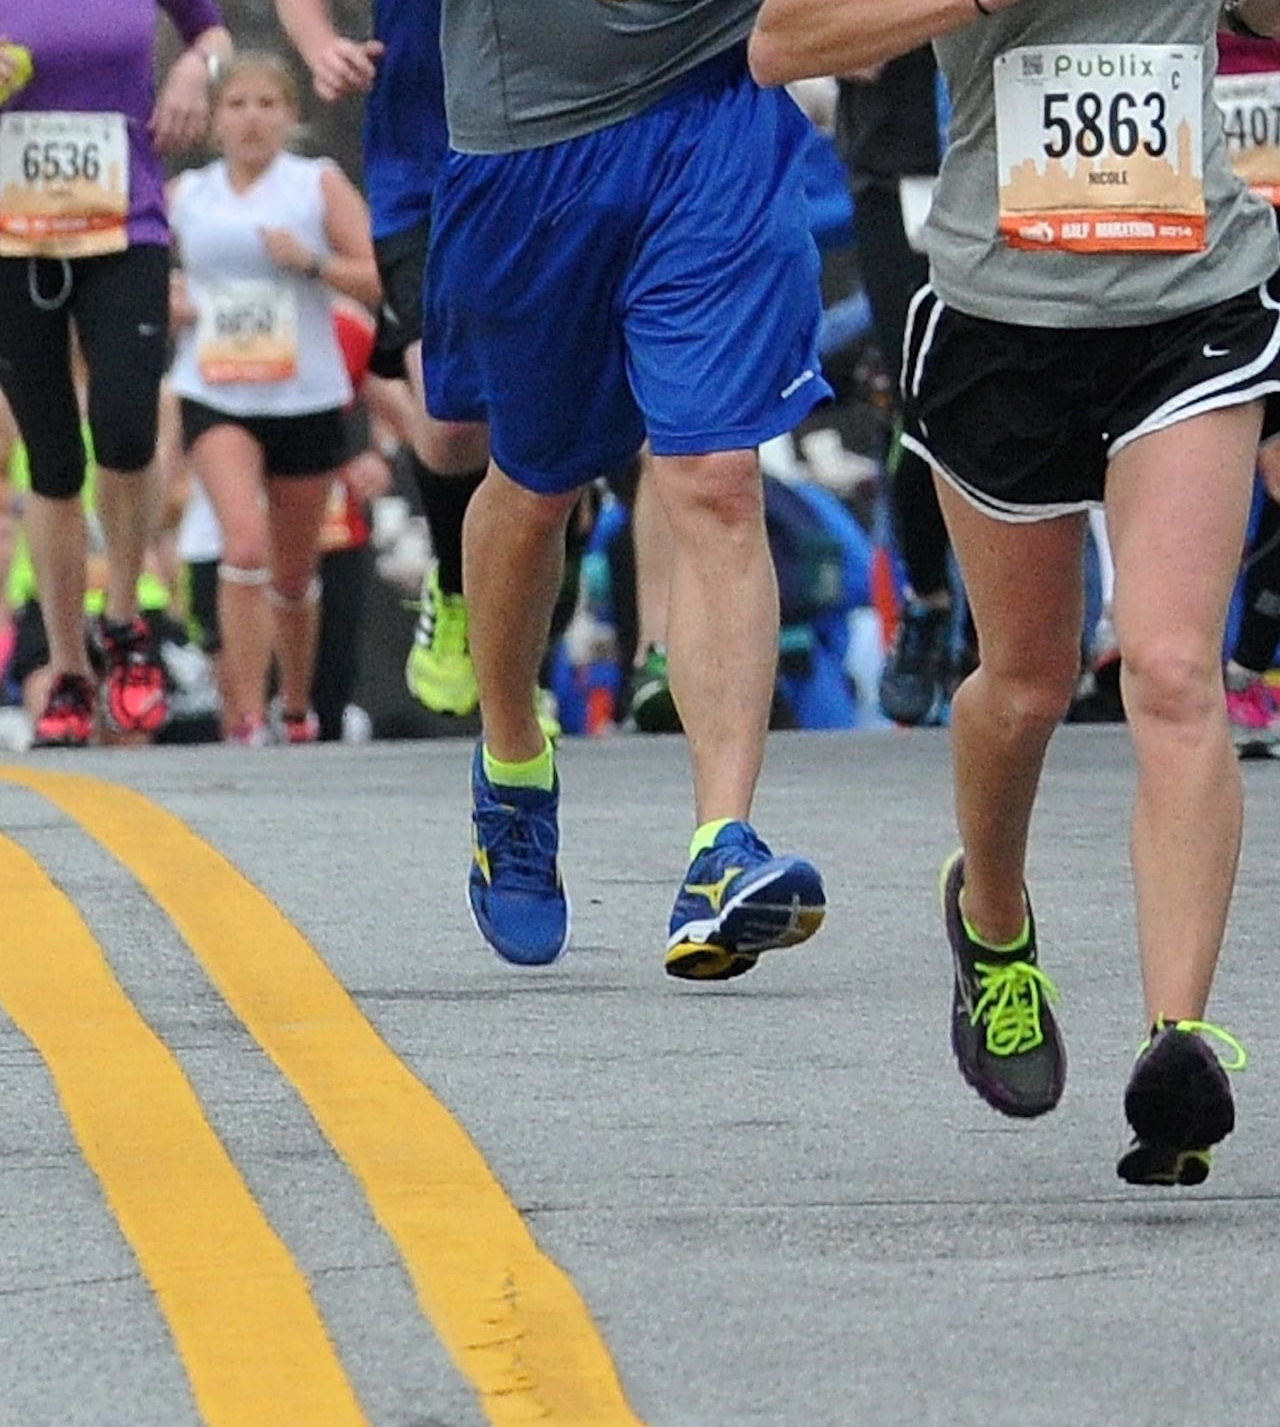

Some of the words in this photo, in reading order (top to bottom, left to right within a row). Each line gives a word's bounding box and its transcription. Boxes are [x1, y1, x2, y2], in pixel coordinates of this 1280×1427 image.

[1054, 54, 1155, 78] Publix
[1171, 70, 1181, 90] C
[1043, 91, 1168, 158] 5863
[23, 141, 99, 182] 6536
[1088, 170, 1129, 185] NICOLE
